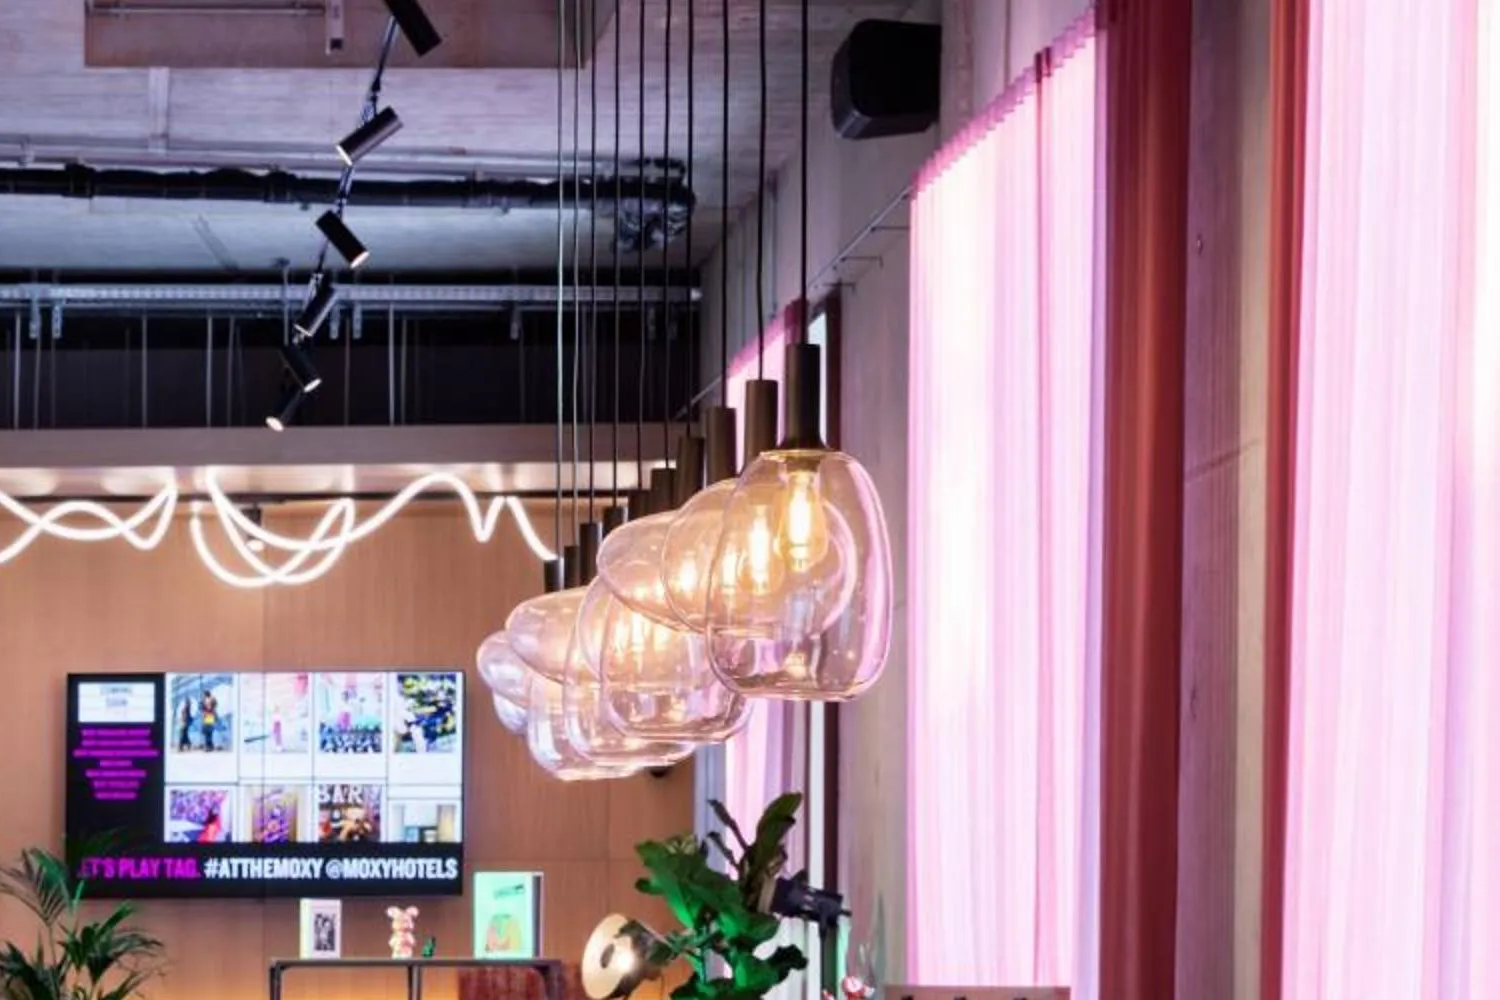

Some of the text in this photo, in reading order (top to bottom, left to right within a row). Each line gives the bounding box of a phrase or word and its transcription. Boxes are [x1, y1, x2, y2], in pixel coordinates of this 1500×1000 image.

[77, 857, 115, 878] ET'S
[118, 857, 160, 878] PLAY
[203, 857, 324, 879] #ATTHEMOXY
[325, 857, 458, 880] @MOXYHOTELS
